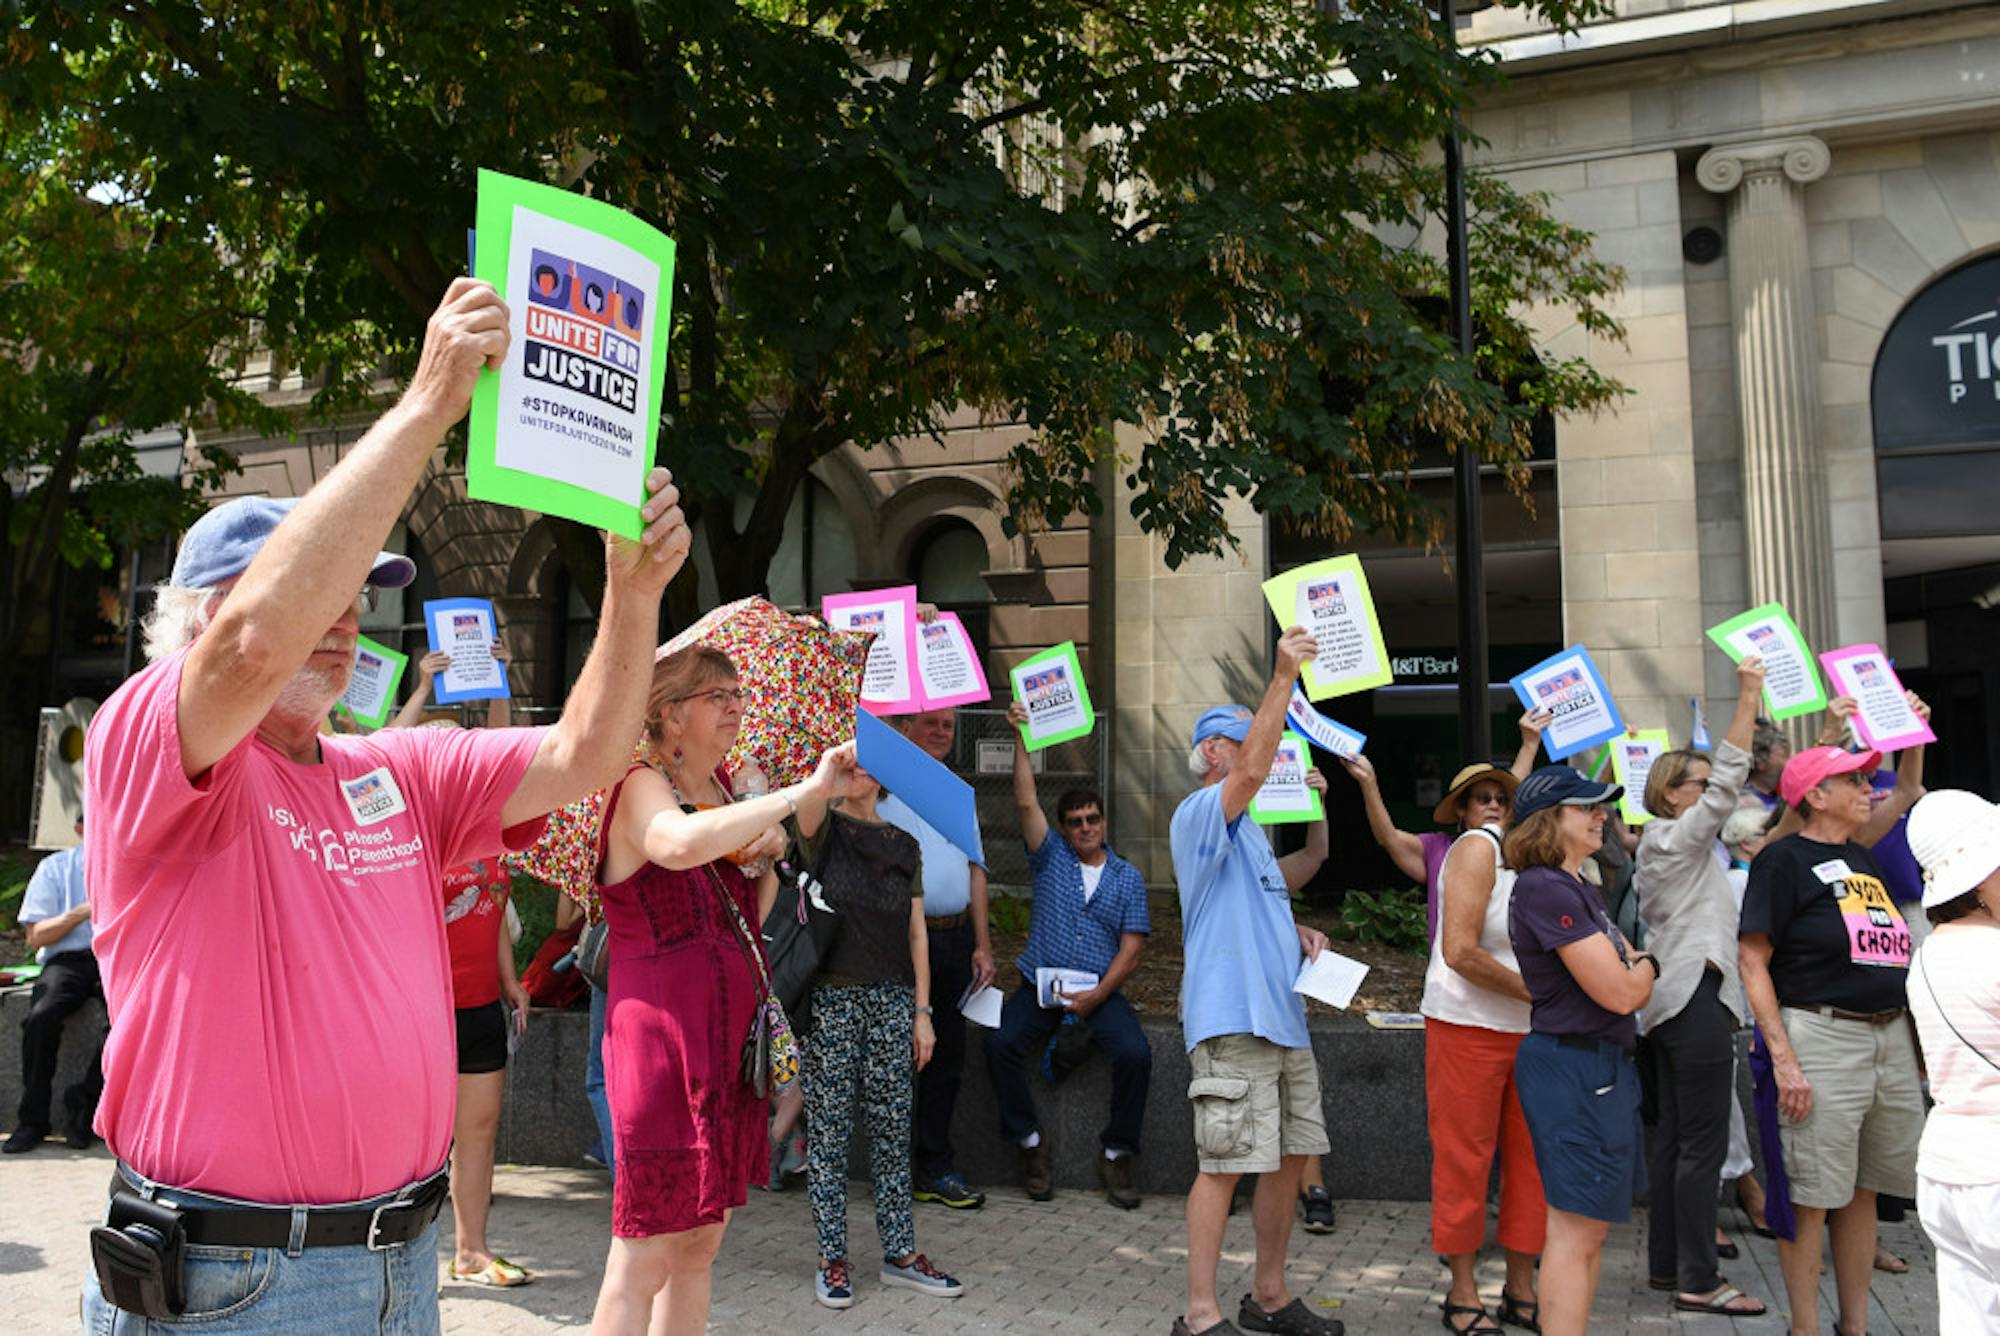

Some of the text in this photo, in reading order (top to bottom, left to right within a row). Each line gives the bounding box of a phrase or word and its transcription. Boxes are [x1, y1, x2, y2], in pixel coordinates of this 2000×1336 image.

[531, 310, 638, 372] UNITE FOR
[527, 346, 637, 410] JUSTICE
[521, 396, 633, 443] #STOPKAVANAUGH
[1264, 774, 1302, 785] USTICE
[347, 834, 423, 864] Paenthood
[1857, 929, 1911, 956] CHOIC
